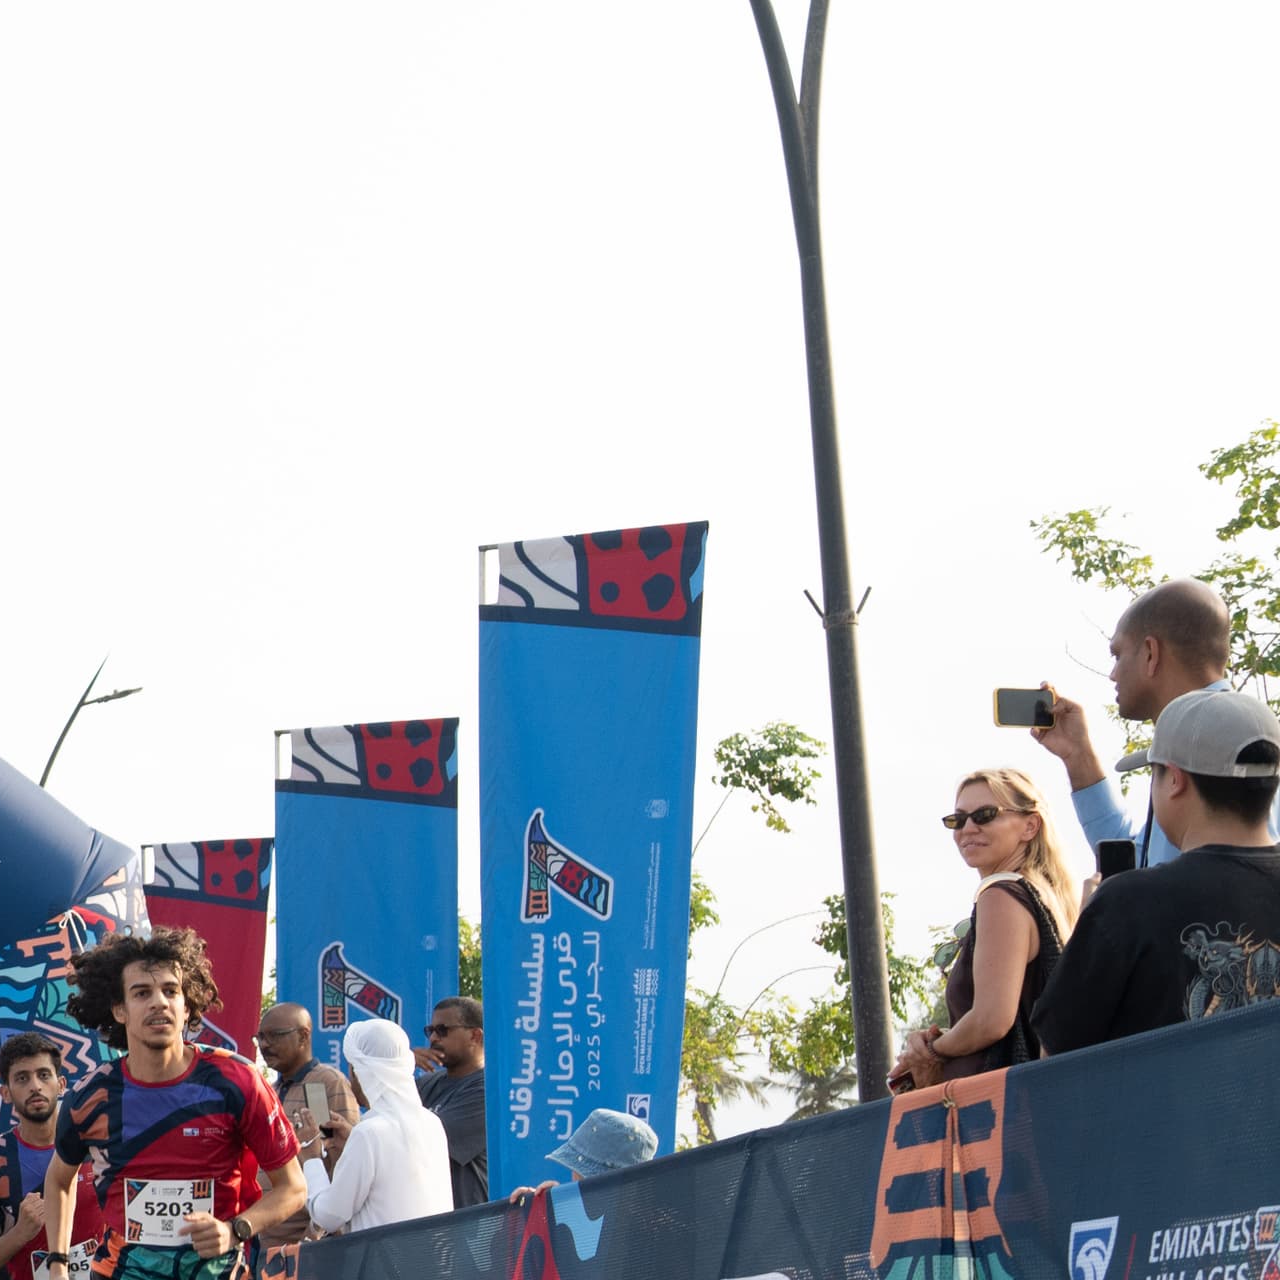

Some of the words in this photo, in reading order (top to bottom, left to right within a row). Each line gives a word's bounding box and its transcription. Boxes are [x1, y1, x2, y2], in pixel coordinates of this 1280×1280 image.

[514, 933, 545, 1033] سلسلة
[552, 931, 577, 1006] قرى
[583, 931, 606, 1028] للجري
[509, 1039, 542, 1139] سباقات
[547, 1011, 581, 1141] الإمارات
[587, 1034, 601, 1091] 2025
[144, 1202, 194, 1217] 5203
[1148, 1215, 1251, 1263] EMIRATES
